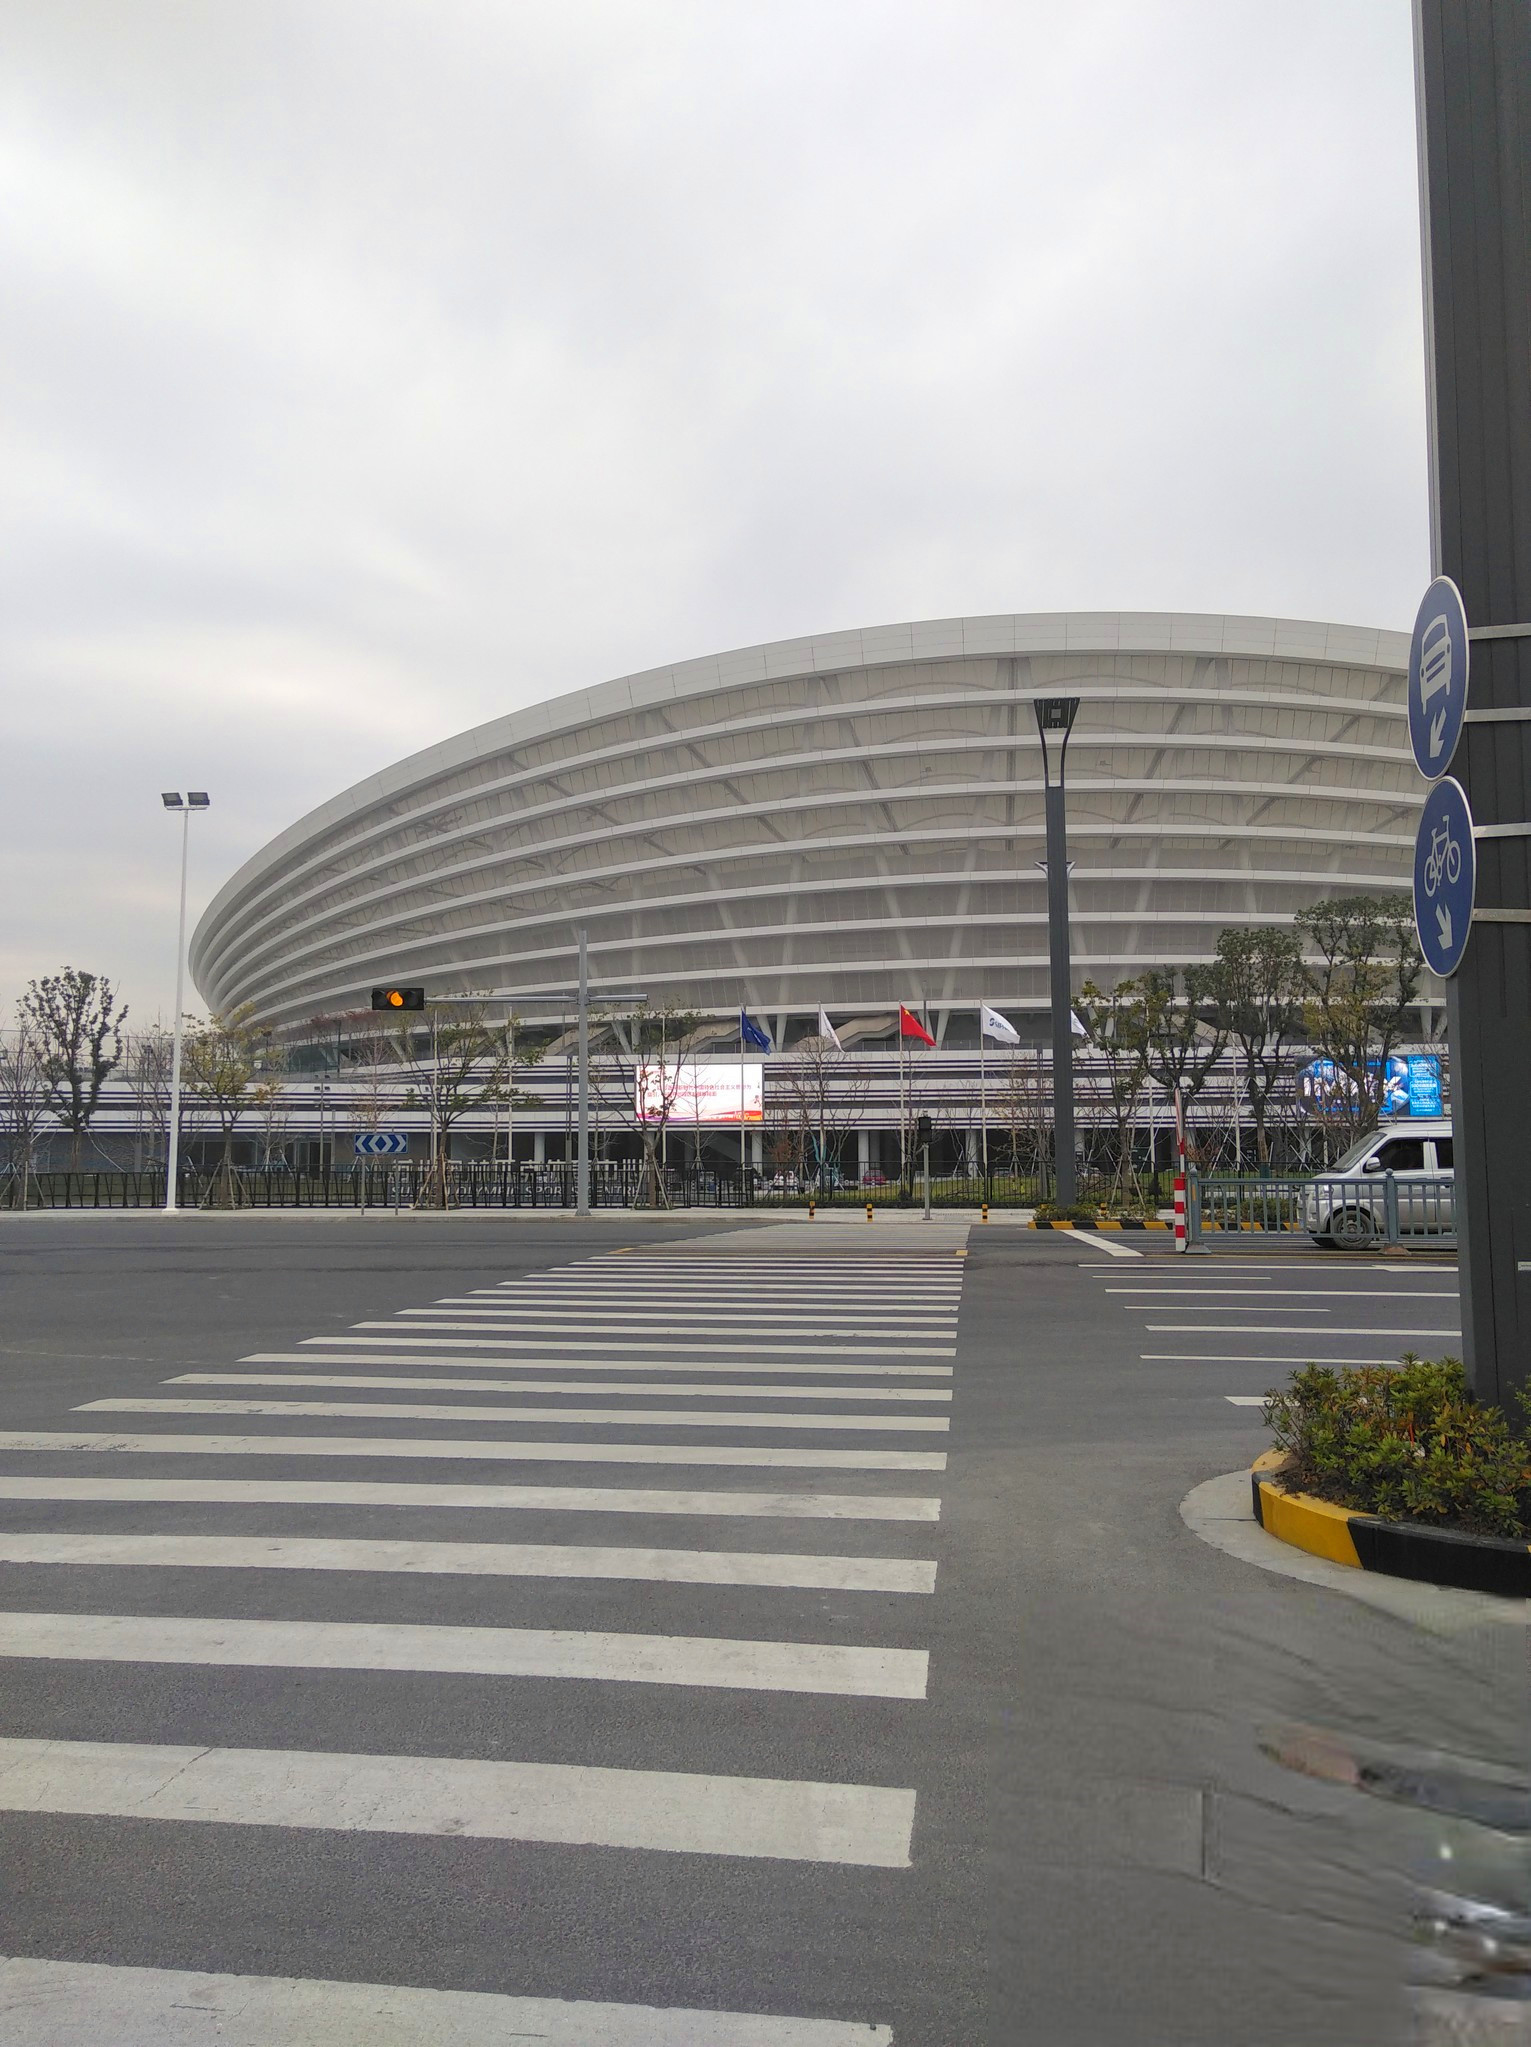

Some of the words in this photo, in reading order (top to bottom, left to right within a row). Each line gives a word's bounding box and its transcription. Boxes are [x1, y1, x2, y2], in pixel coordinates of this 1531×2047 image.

[391, 1159, 647, 1184] 苏州奥林匹克体中心
[391, 1186, 451, 1198] SUO
[525, 1186, 578, 1198] SPORS
